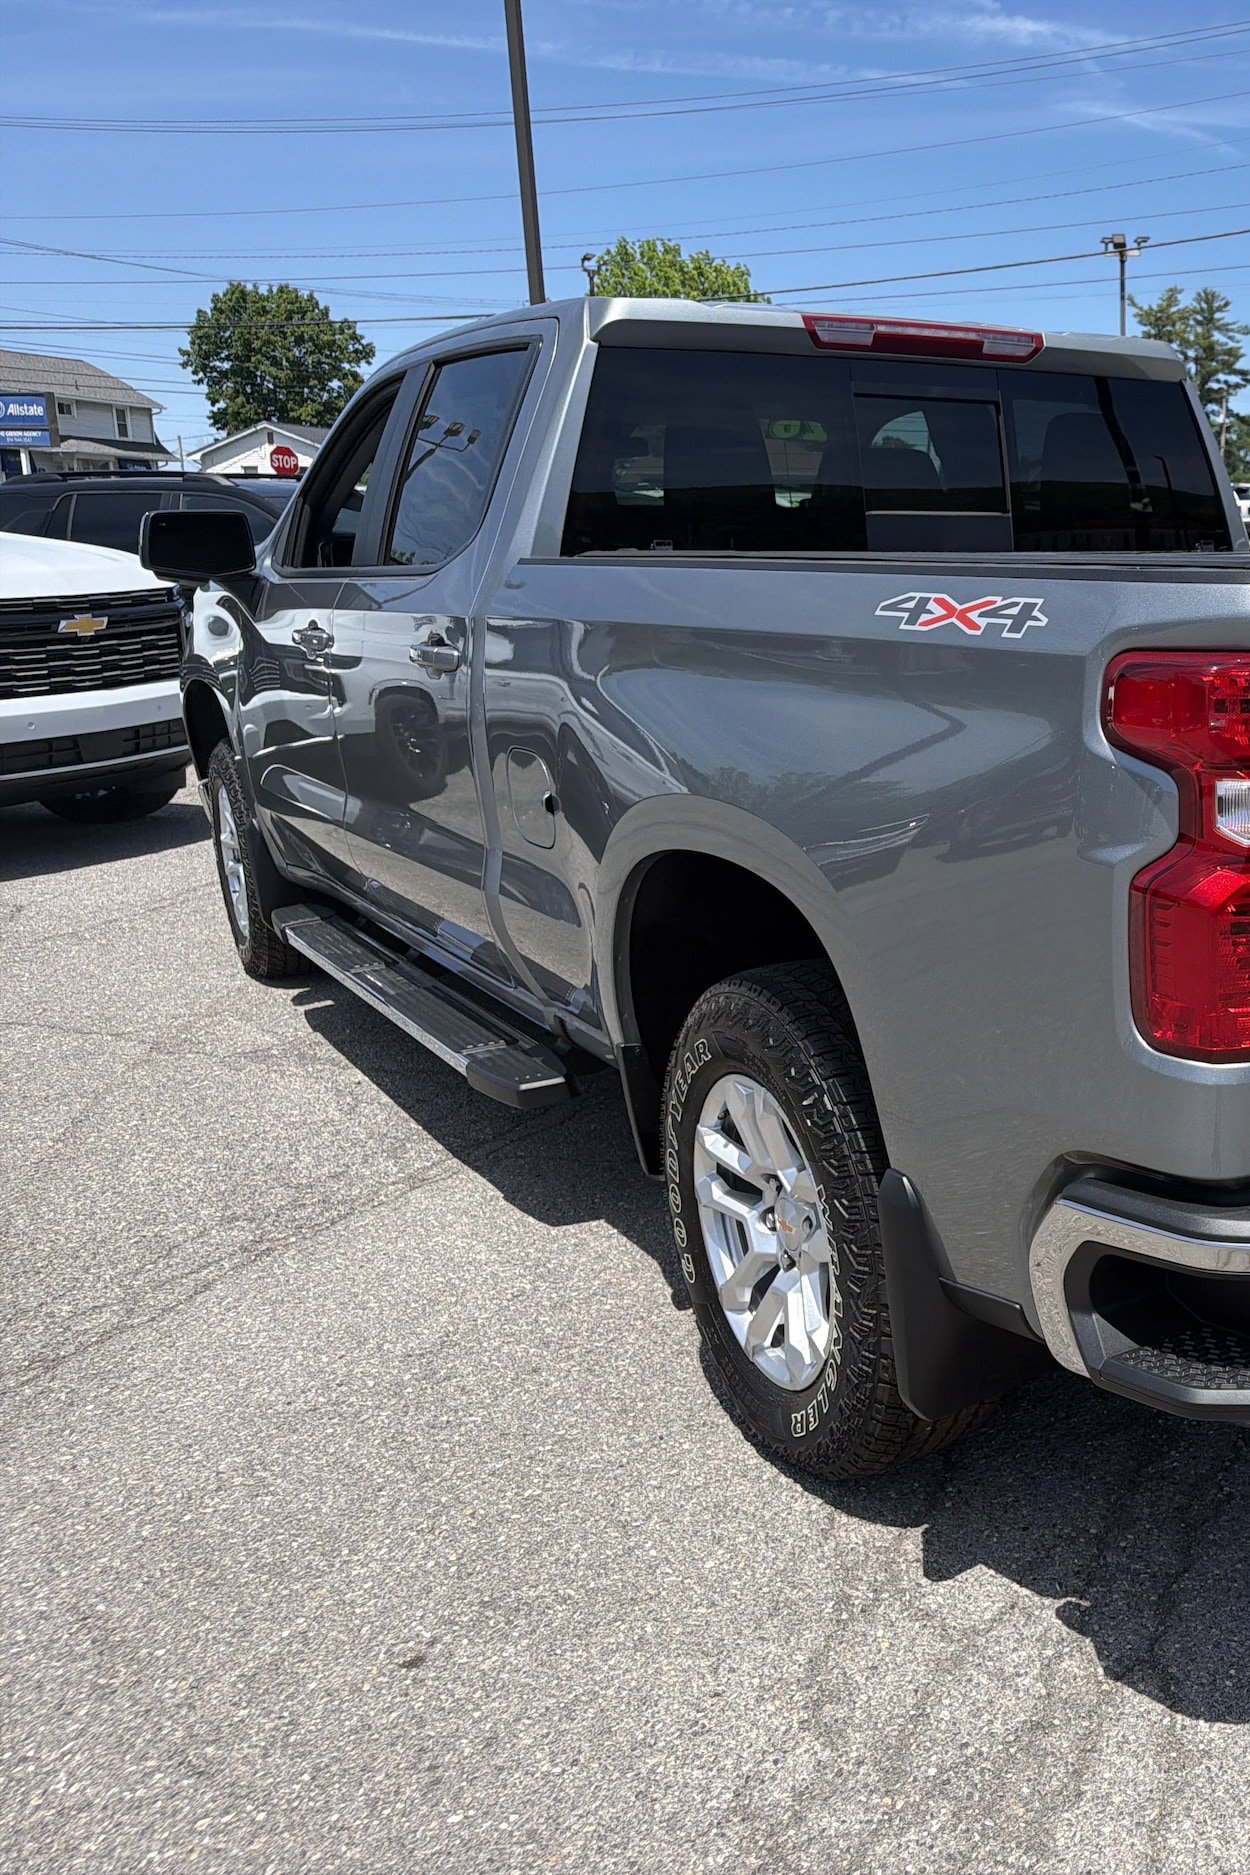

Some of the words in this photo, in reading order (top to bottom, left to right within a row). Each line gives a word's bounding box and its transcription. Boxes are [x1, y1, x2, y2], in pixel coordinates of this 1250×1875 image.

[7, 403, 44, 416] Allstate
[272, 454, 297, 469] STOP
[667, 1038, 712, 1284] GOODYEAR
[791, 1184, 844, 1438] WRANGLER
